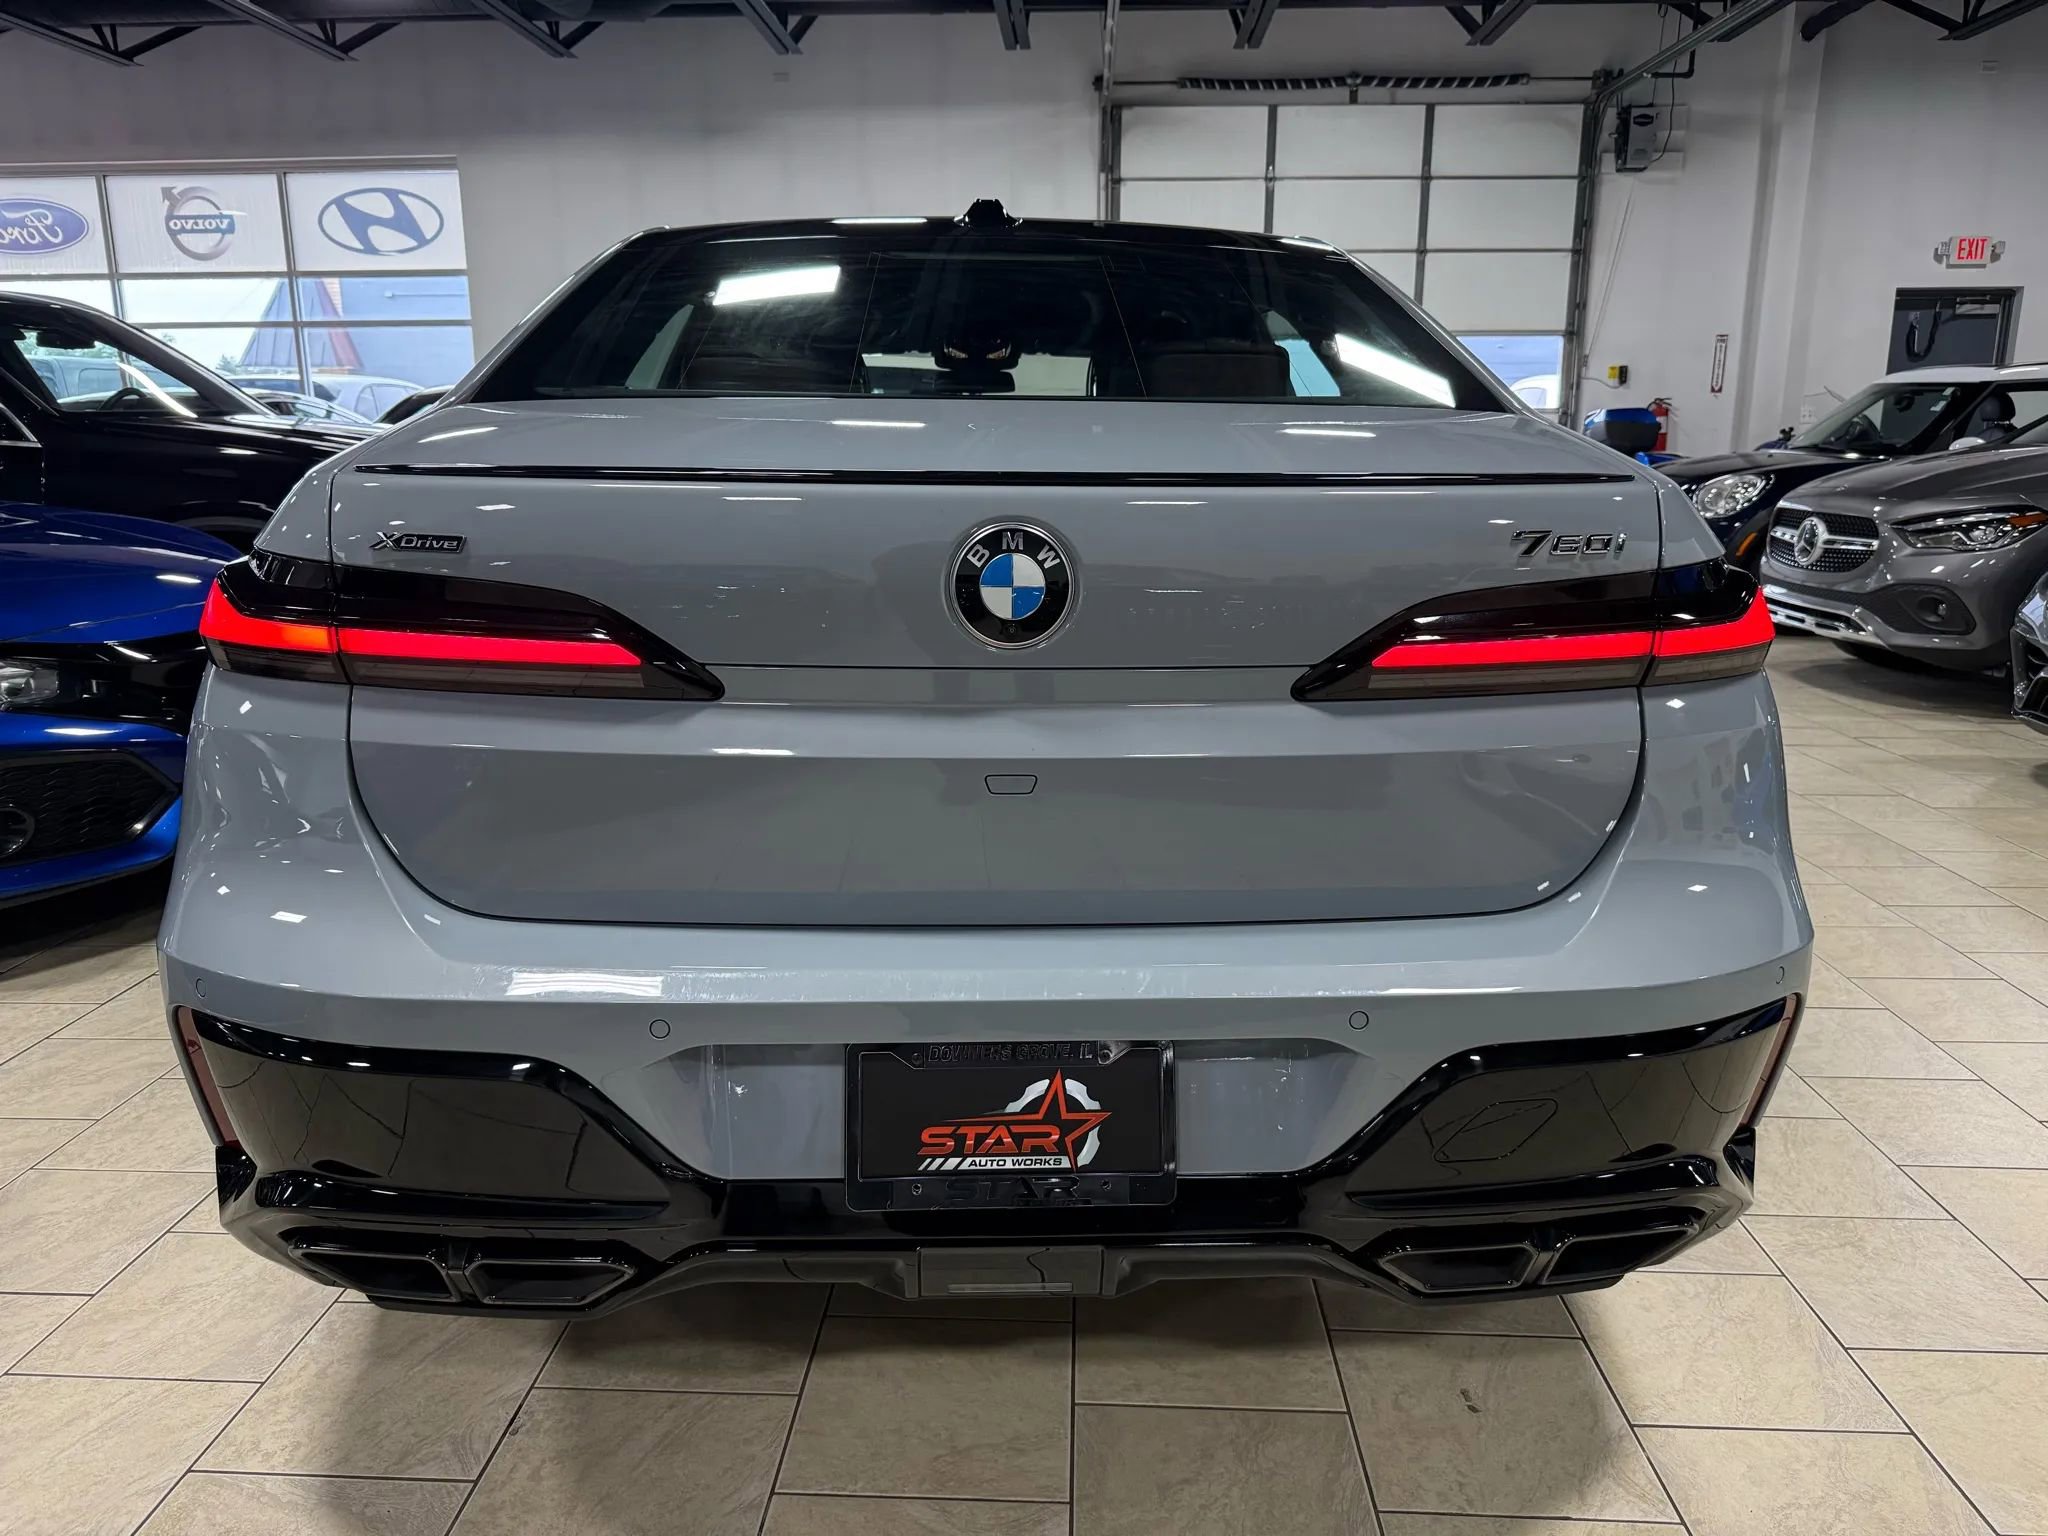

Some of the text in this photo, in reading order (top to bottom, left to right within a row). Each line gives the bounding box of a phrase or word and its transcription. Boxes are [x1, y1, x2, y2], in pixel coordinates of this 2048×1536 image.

[1957, 238, 1988, 260] EXIT
[965, 531, 1061, 569] BMW
[1510, 529, 1627, 557] 760i
[1079, 1043, 1093, 1059] IL
[917, 1125, 1061, 1155] STAR
[968, 1157, 1063, 1168] AUTO WORKS
[946, 1175, 1080, 1200] STAR
